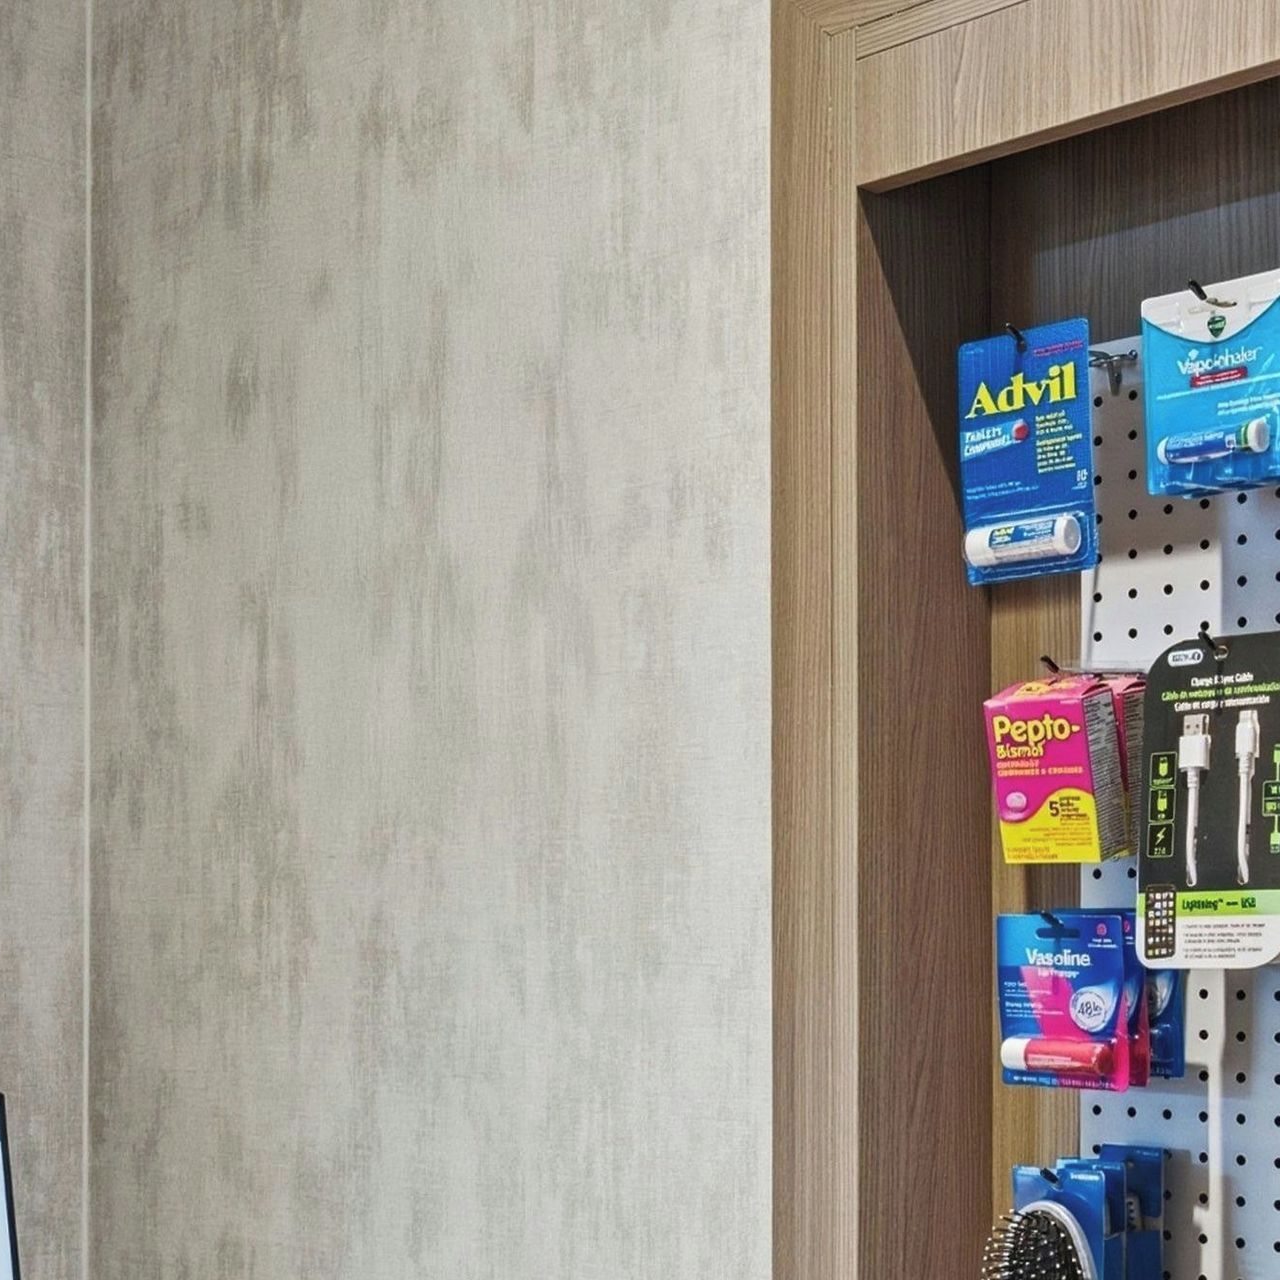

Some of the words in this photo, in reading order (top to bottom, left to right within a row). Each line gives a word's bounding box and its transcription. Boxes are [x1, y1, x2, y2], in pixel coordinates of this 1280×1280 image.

[964, 361, 1077, 419] Advil
[992, 713, 1081, 745] Pepto-
[996, 742, 1046, 760] Bismol
[1049, 801, 1060, 817] 5
